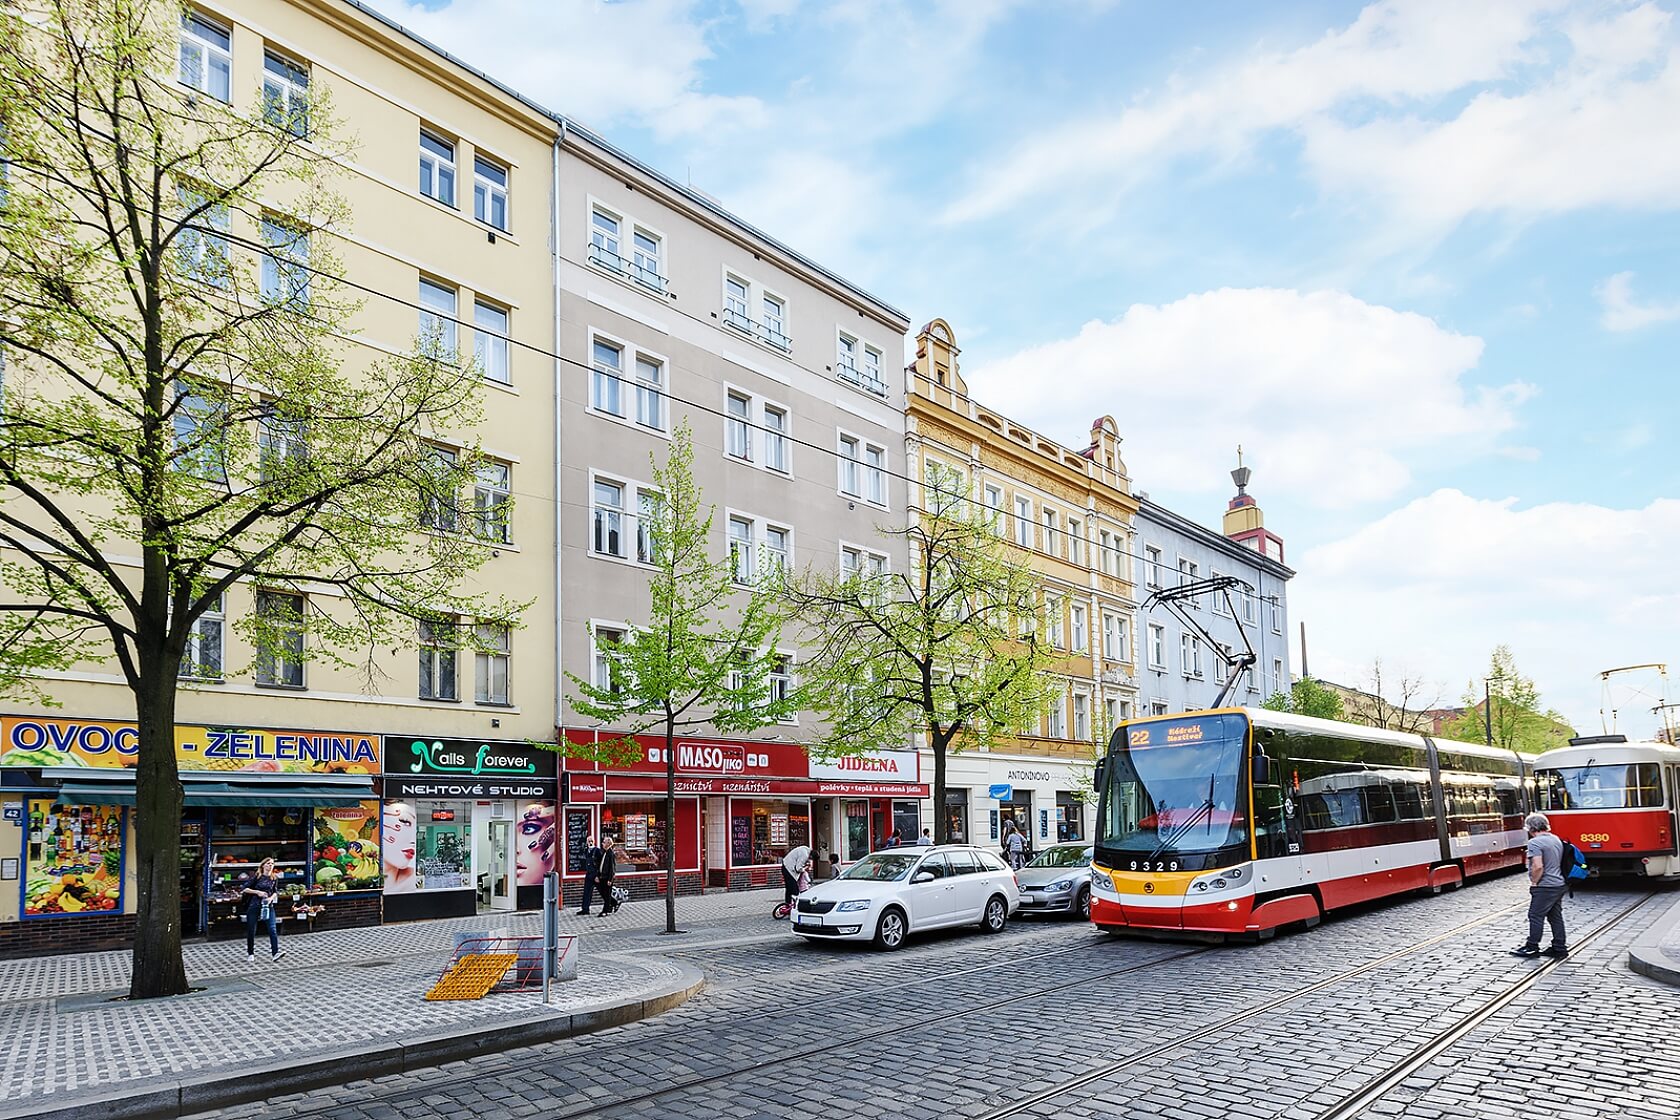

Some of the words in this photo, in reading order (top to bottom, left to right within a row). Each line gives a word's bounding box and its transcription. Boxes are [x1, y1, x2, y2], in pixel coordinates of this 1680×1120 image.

[11, 722, 139, 755] OVOC
[204, 732, 376, 762] ZELENINA
[1131, 731, 1150, 745] 22
[678, 746, 723, 768] MASO
[401, 784, 483, 796] NEHTOVÉ
[489, 786, 545, 796] STUDIO
[723, 780, 771, 792] uzenářství
[820, 783, 850, 792] polévky
[855, 784, 873, 793] teplá
[880, 784, 905, 793] studená
[906, 785, 921, 794] jídla
[1582, 796, 1603, 806] 22
[6, 810, 19, 818] 42
[1580, 833, 1610, 842] 8380
[1130, 861, 1178, 871] 9329
